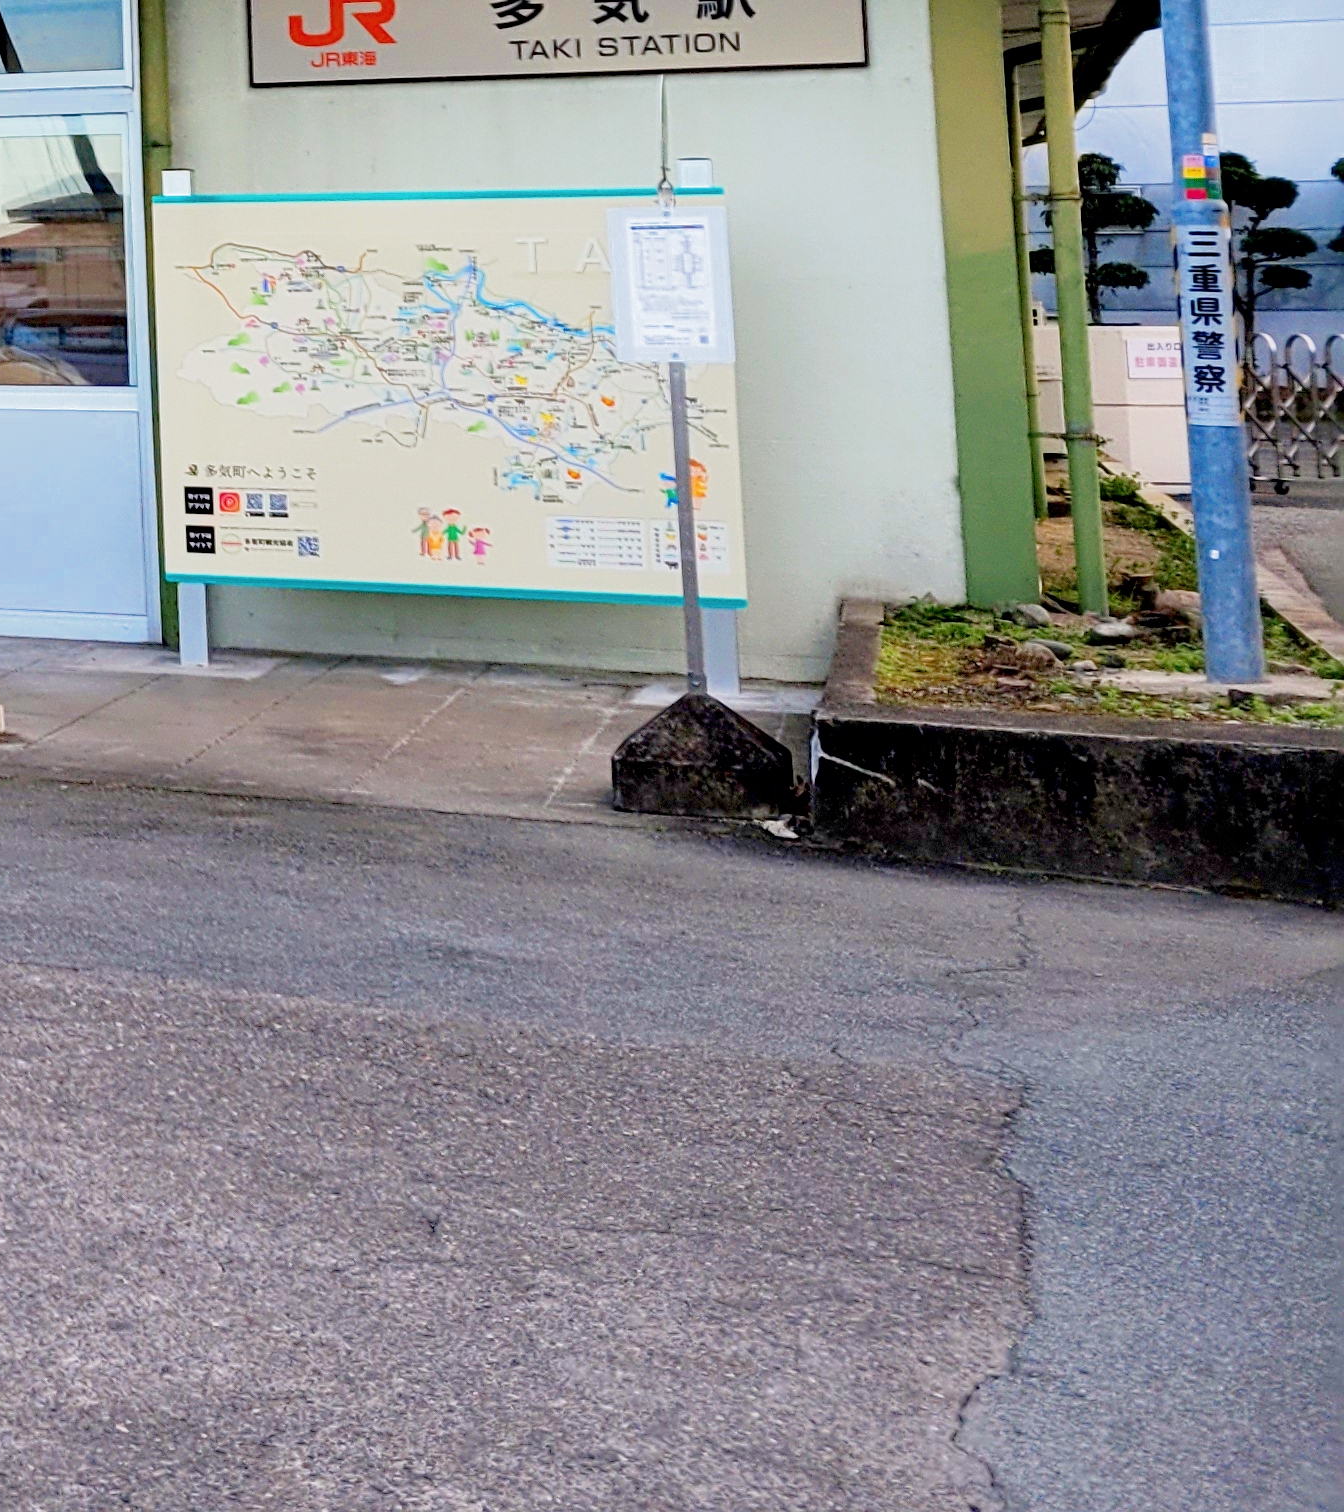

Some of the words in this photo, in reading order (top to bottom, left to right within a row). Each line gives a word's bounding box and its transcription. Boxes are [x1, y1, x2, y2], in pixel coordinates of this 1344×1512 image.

[509, 37, 582, 61] TAKI
[598, 31, 742, 57] STATION
[310, 51, 376, 69] JR東海
[1187, 231, 1226, 393] 三重県警察
[1147, 342, 1182, 351] 出入り口
[205, 464, 317, 480] 多気町へようこそ
